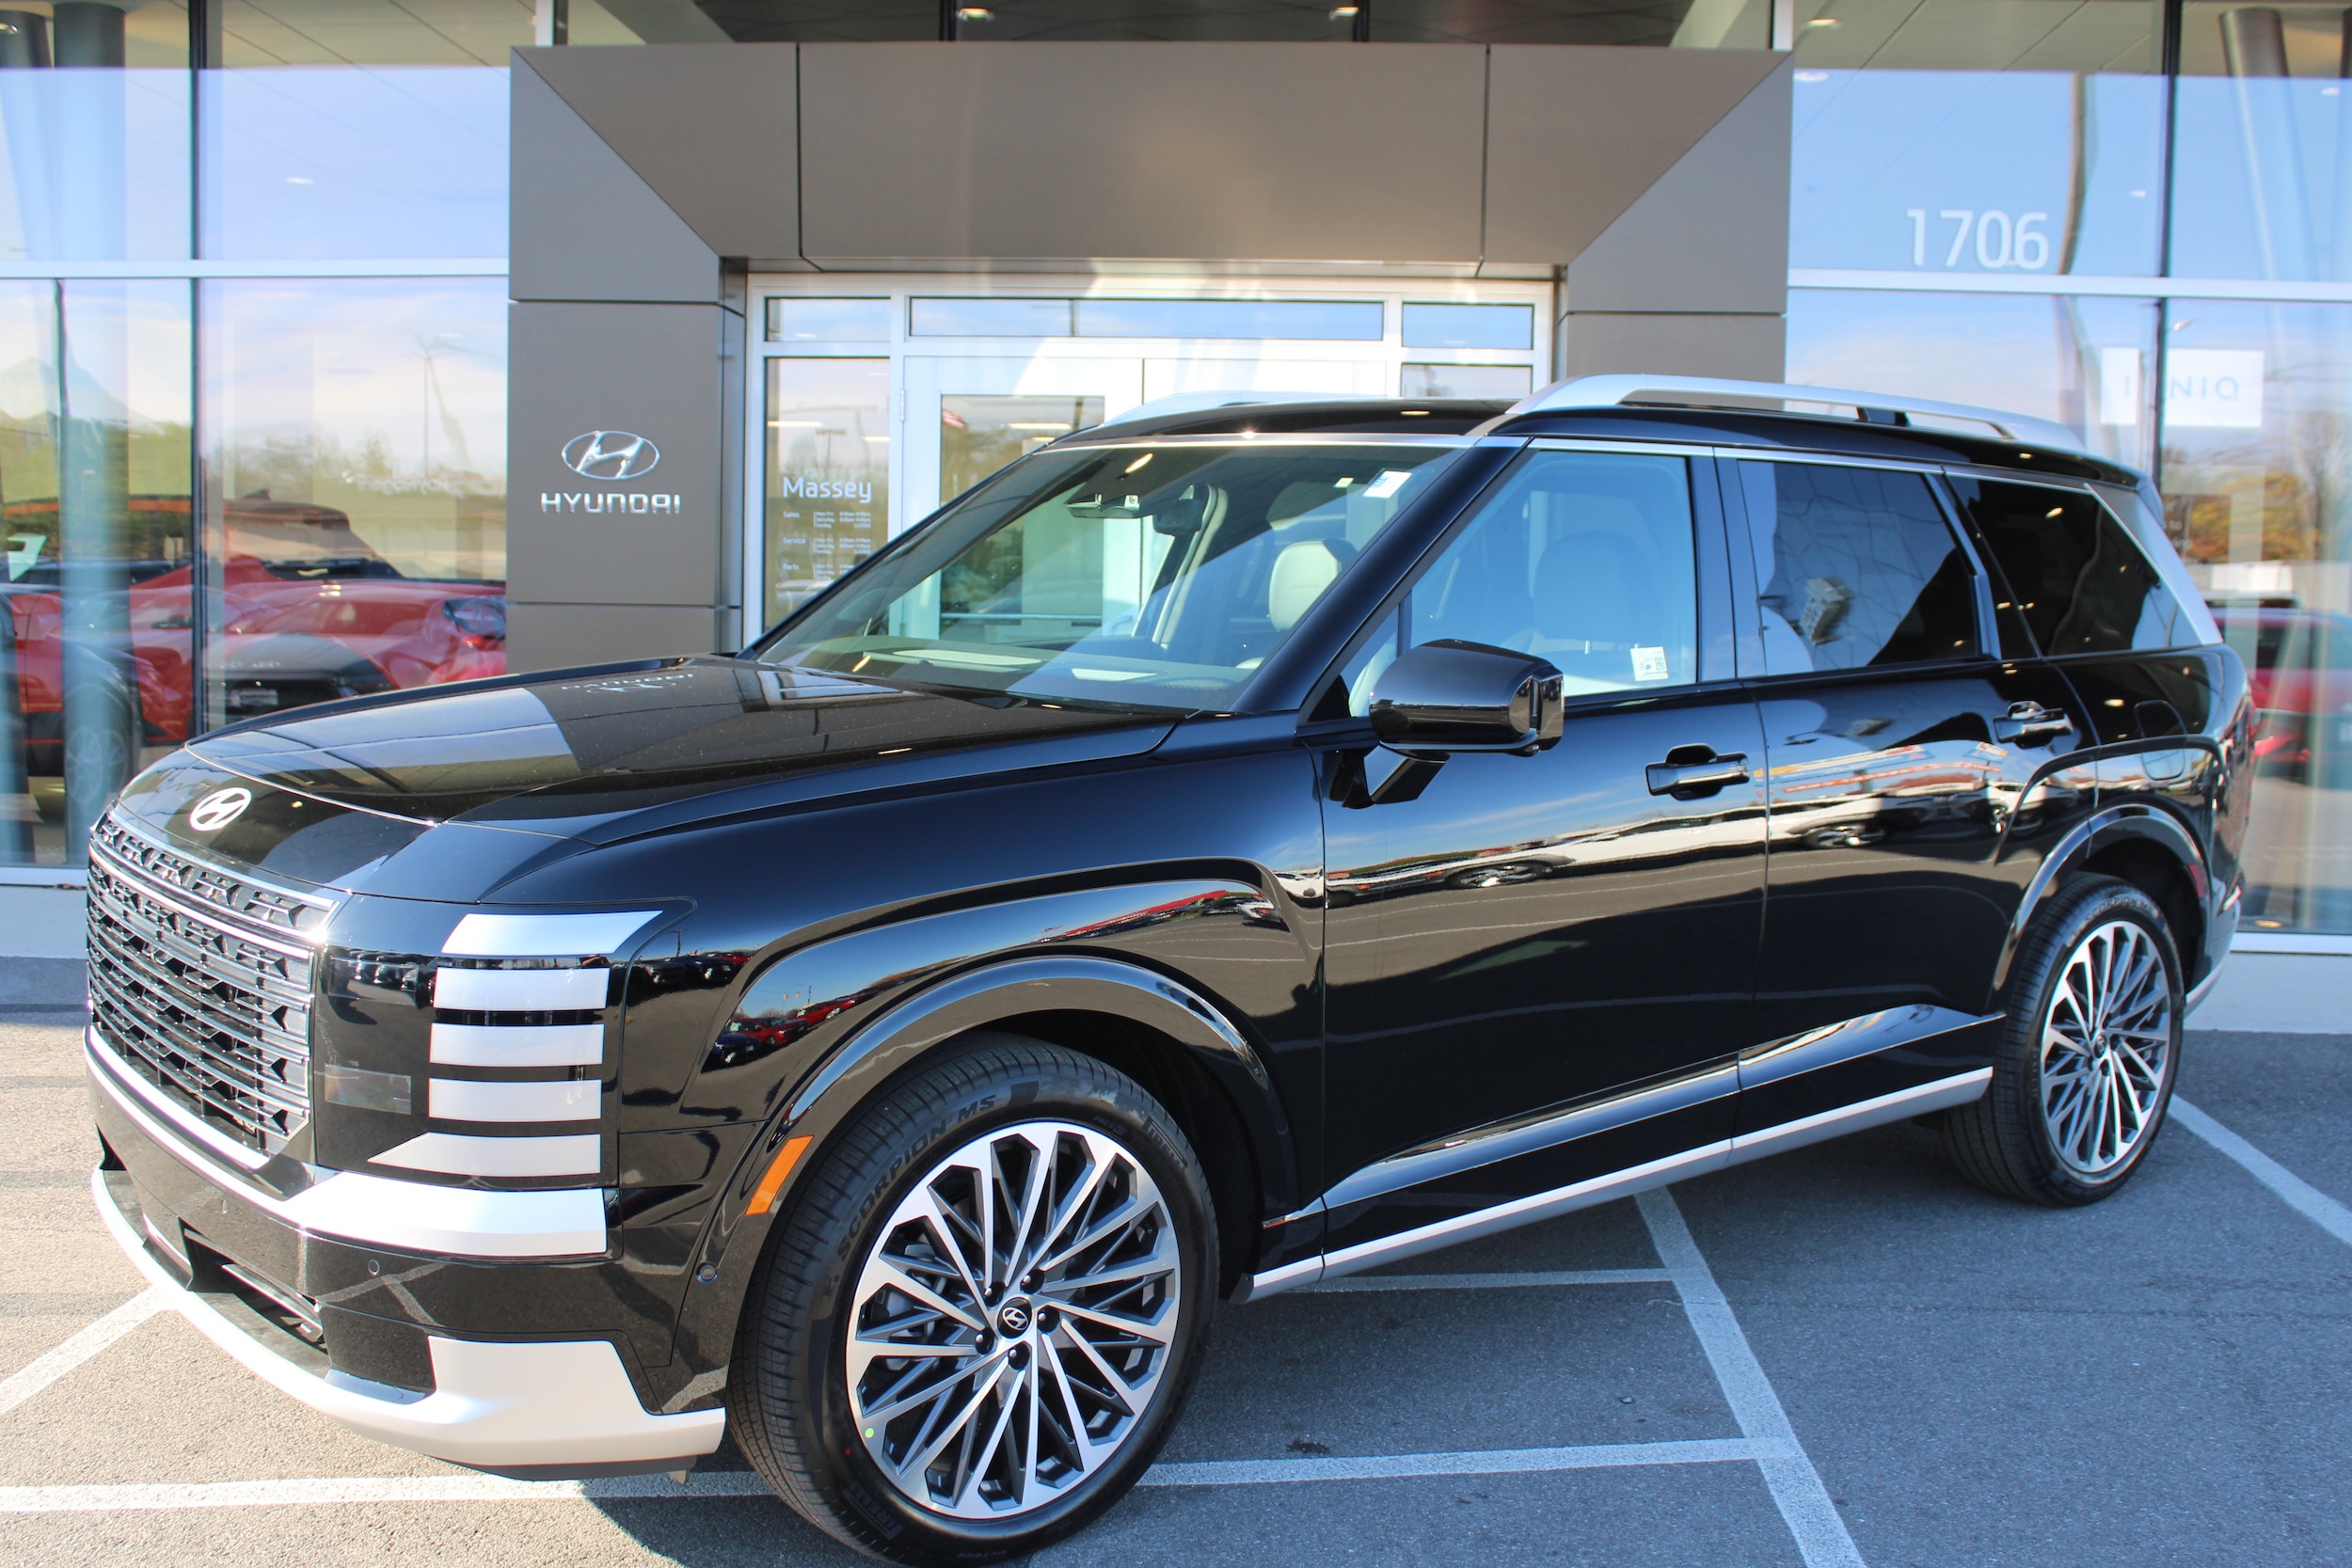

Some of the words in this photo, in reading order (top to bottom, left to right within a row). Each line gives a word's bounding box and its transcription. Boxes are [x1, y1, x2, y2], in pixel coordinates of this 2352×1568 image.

[1906, 209, 2049, 269] 1706
[2124, 373, 2240, 402] INIQ
[540, 492, 682, 515] HYUNDAI
[783, 476, 872, 504] Massey
[836, 1122, 947, 1260] SCORPION
[956, 1094, 996, 1124] MS
